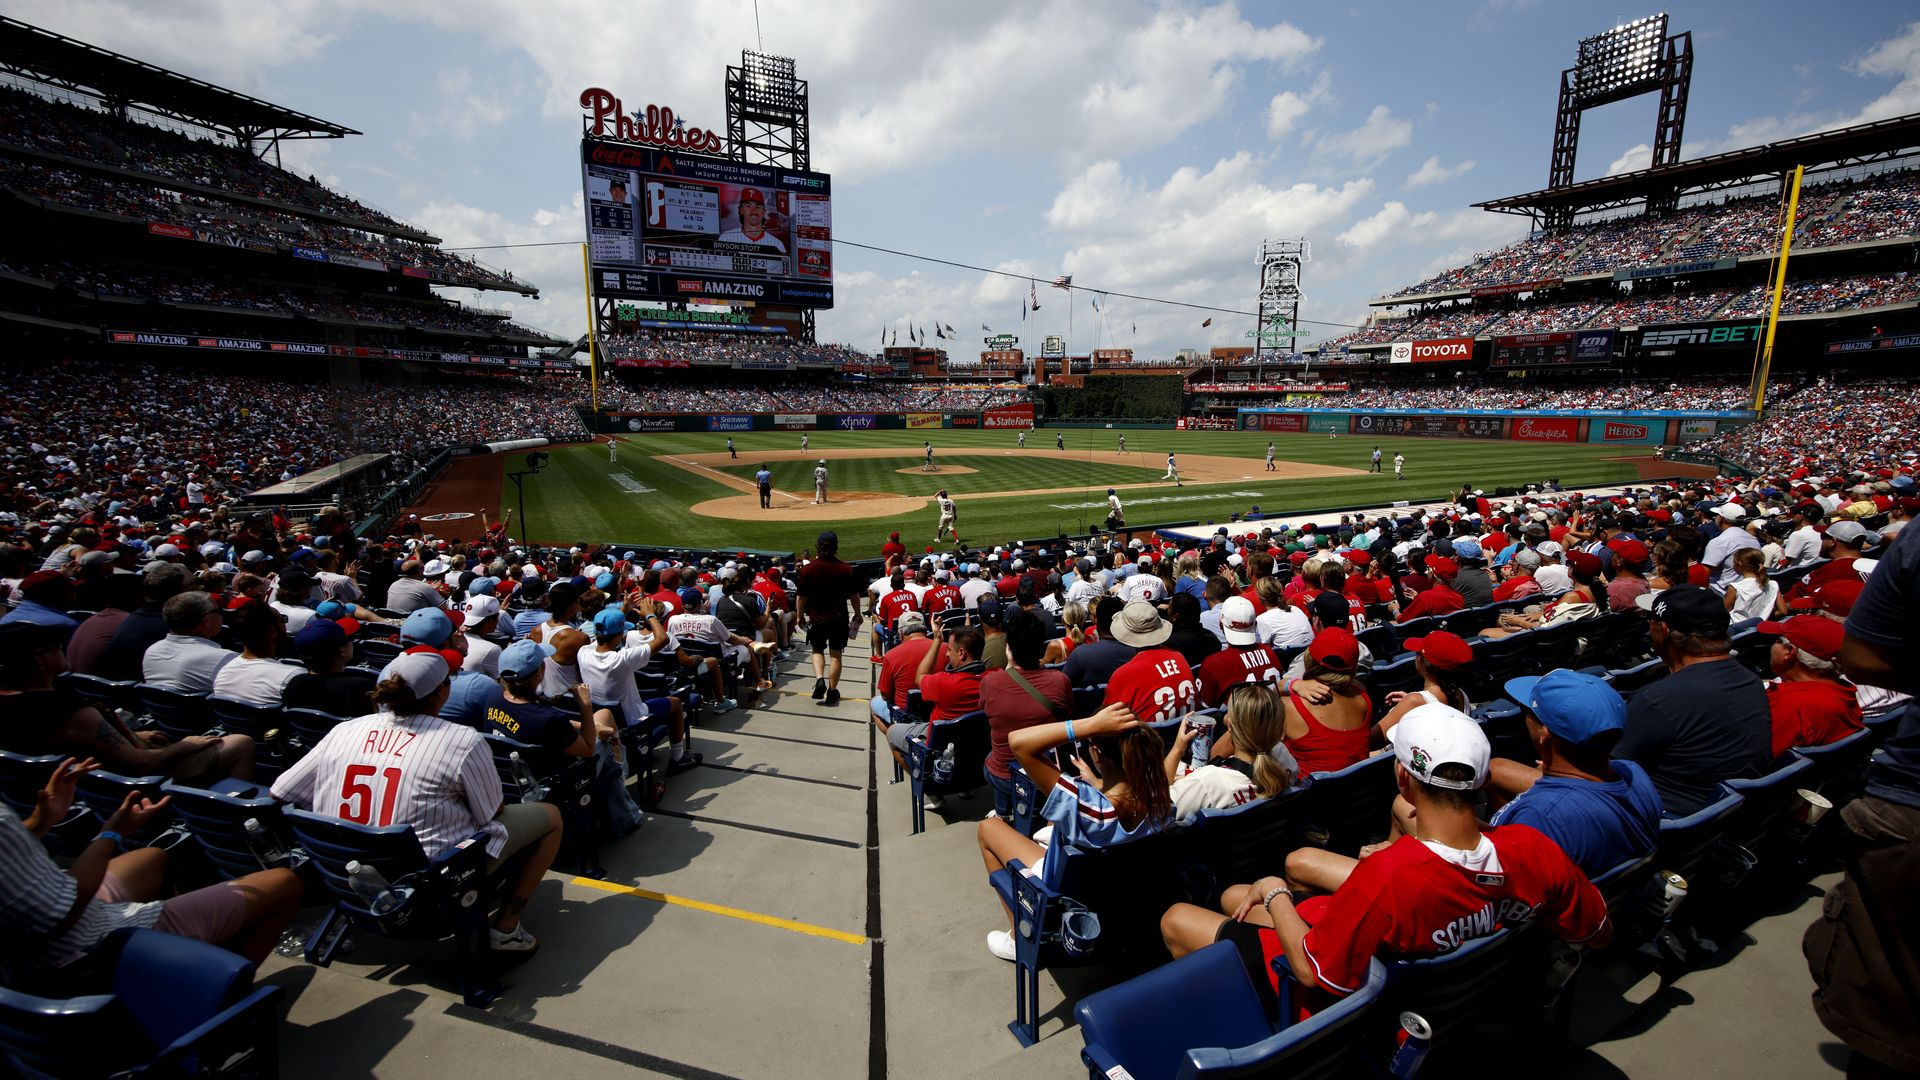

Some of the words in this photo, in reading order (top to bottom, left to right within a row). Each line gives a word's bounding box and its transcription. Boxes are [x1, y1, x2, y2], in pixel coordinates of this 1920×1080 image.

[580, 87, 721, 153] Phillies
[675, 159, 694, 168] SALTZ
[697, 162, 738, 173] MONGELUZZI
[740, 167, 772, 177] BENDESKY
[695, 171, 720, 179] INJURY
[724, 174, 754, 183] LAWYERS
[783, 175, 806, 186] ESPN
[807, 179, 825, 188] BET
[713, 241, 739, 250] BRYSON
[740, 244, 761, 252] STOTT
[753, 260, 766, 268] 2-2
[1630, 264, 1671, 278] LISCIO'S
[1672, 261, 1716, 274] BAKERY
[626, 273, 648, 281] Building
[704, 281, 765, 297] AMAZING
[782, 289, 824, 298] Independence
[1477, 287, 1497, 296] Phillies
[638, 307, 690, 321] Citizens
[691, 309, 722, 322] Bank
[723, 311, 751, 324] Park
[137, 334, 188, 346] AMAZING
[1641, 328, 1709, 346] ESPN
[1709, 324, 1767, 343] BET
[218, 339, 262, 350] AMAZING
[287, 344, 326, 354] AMAZING
[1415, 343, 1467, 357] TOYOTA
[1840, 341, 1872, 351] AMAZING
[841, 416, 871, 428] xfinity
[1608, 426, 1642, 437] HERR'S
[1136, 577, 1159, 589] HARPER
[891, 591, 913, 602] HARPER
[935, 587, 957, 599] HARPER
[943, 597, 953, 609] 3
[674, 622, 702, 633] HARPER
[1239, 648, 1271, 670] KRUK
[1155, 659, 1181, 679] LEE
[487, 706, 521, 734] HARPER
[363, 729, 417, 757] RUIZ
[339, 764, 402, 828] 51
